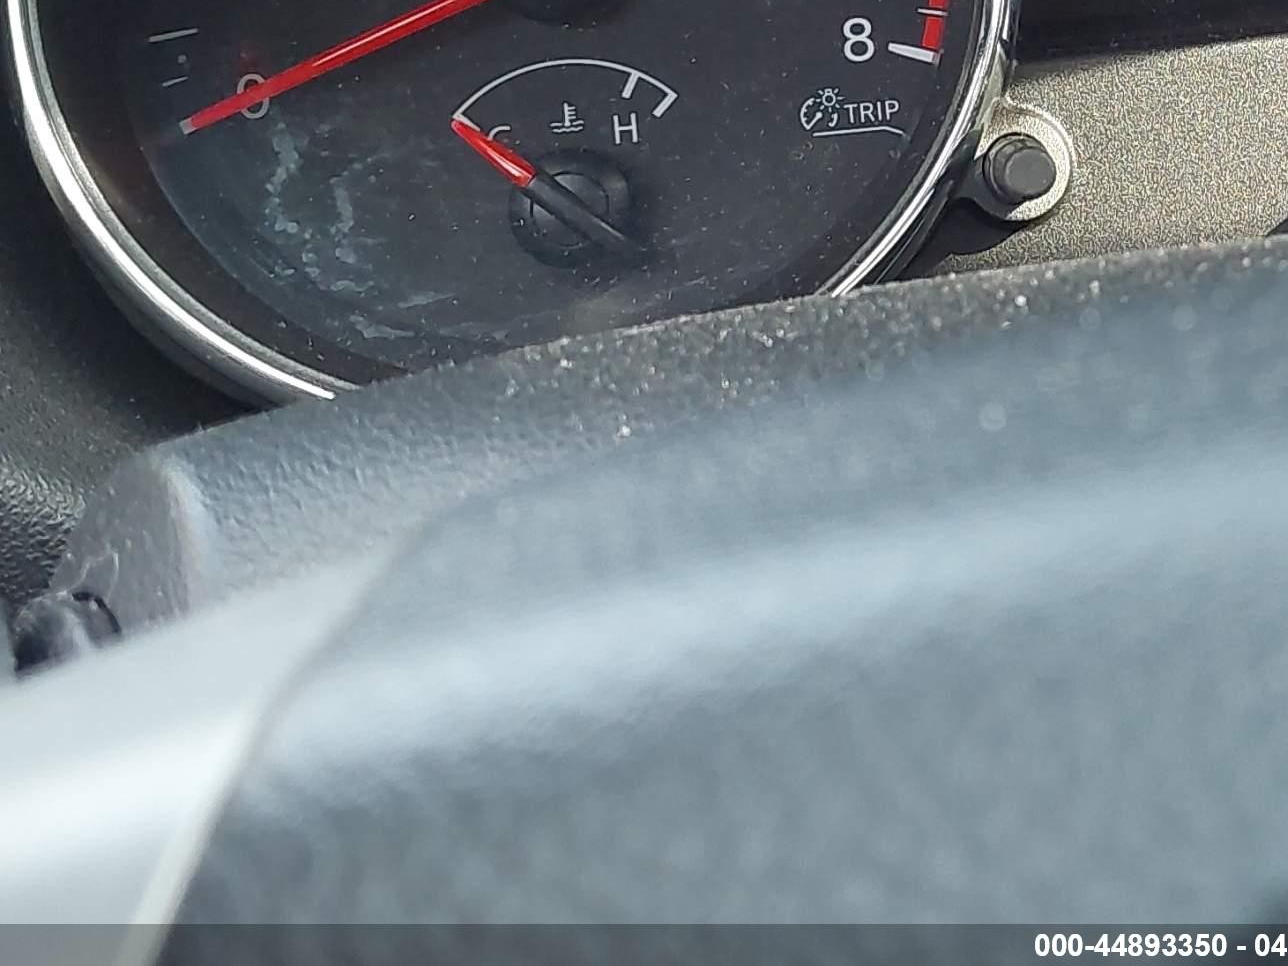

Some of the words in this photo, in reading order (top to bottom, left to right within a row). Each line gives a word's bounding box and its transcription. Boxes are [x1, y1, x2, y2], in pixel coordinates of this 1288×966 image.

[843, 17, 874, 63] 8
[237, 73, 270, 119] 0
[845, 99, 900, 124] TRIP
[612, 112, 639, 144] H
